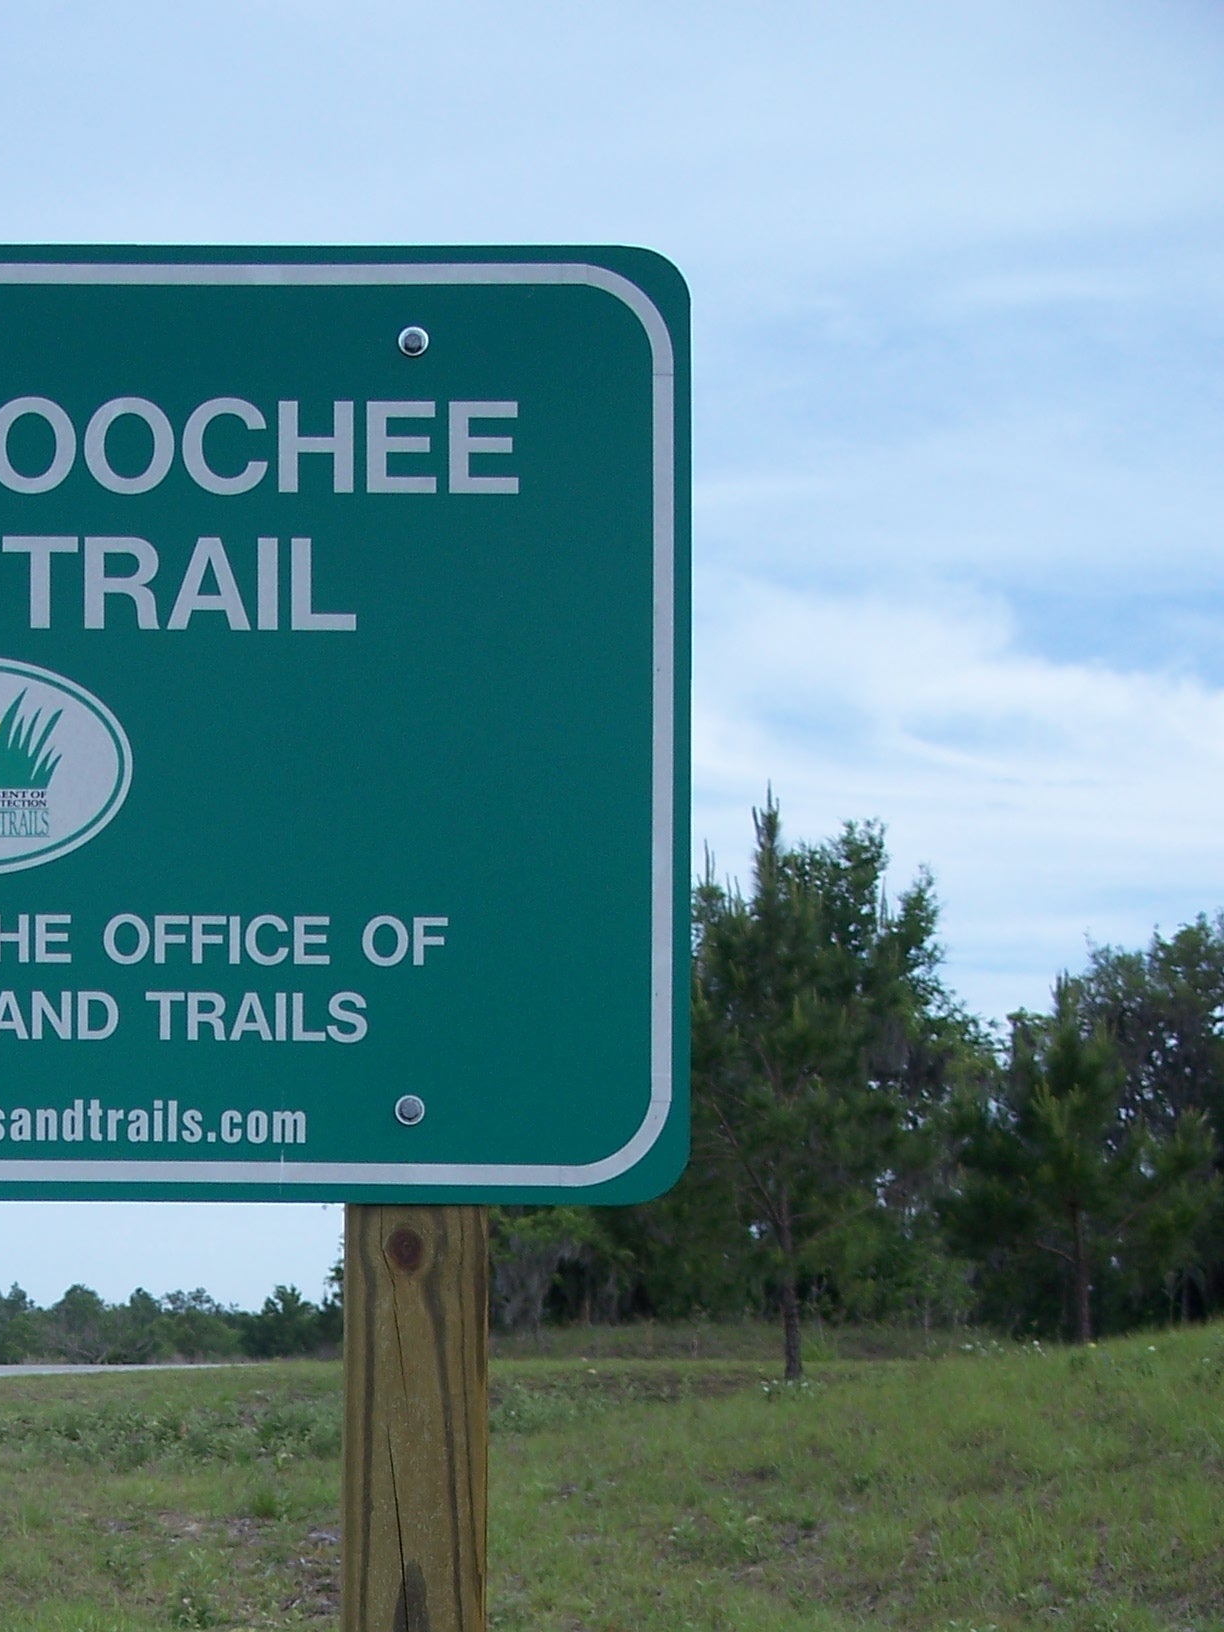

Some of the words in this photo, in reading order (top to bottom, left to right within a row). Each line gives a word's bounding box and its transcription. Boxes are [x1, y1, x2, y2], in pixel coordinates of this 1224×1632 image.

[3, 537, 357, 631] TRAIL
[30, 790, 47, 799] OF
[0, 810, 50, 837] TRAILS
[104, 914, 330, 966] OFFICE
[363, 916, 449, 966] OF
[146, 992, 368, 1043] TRAILS
